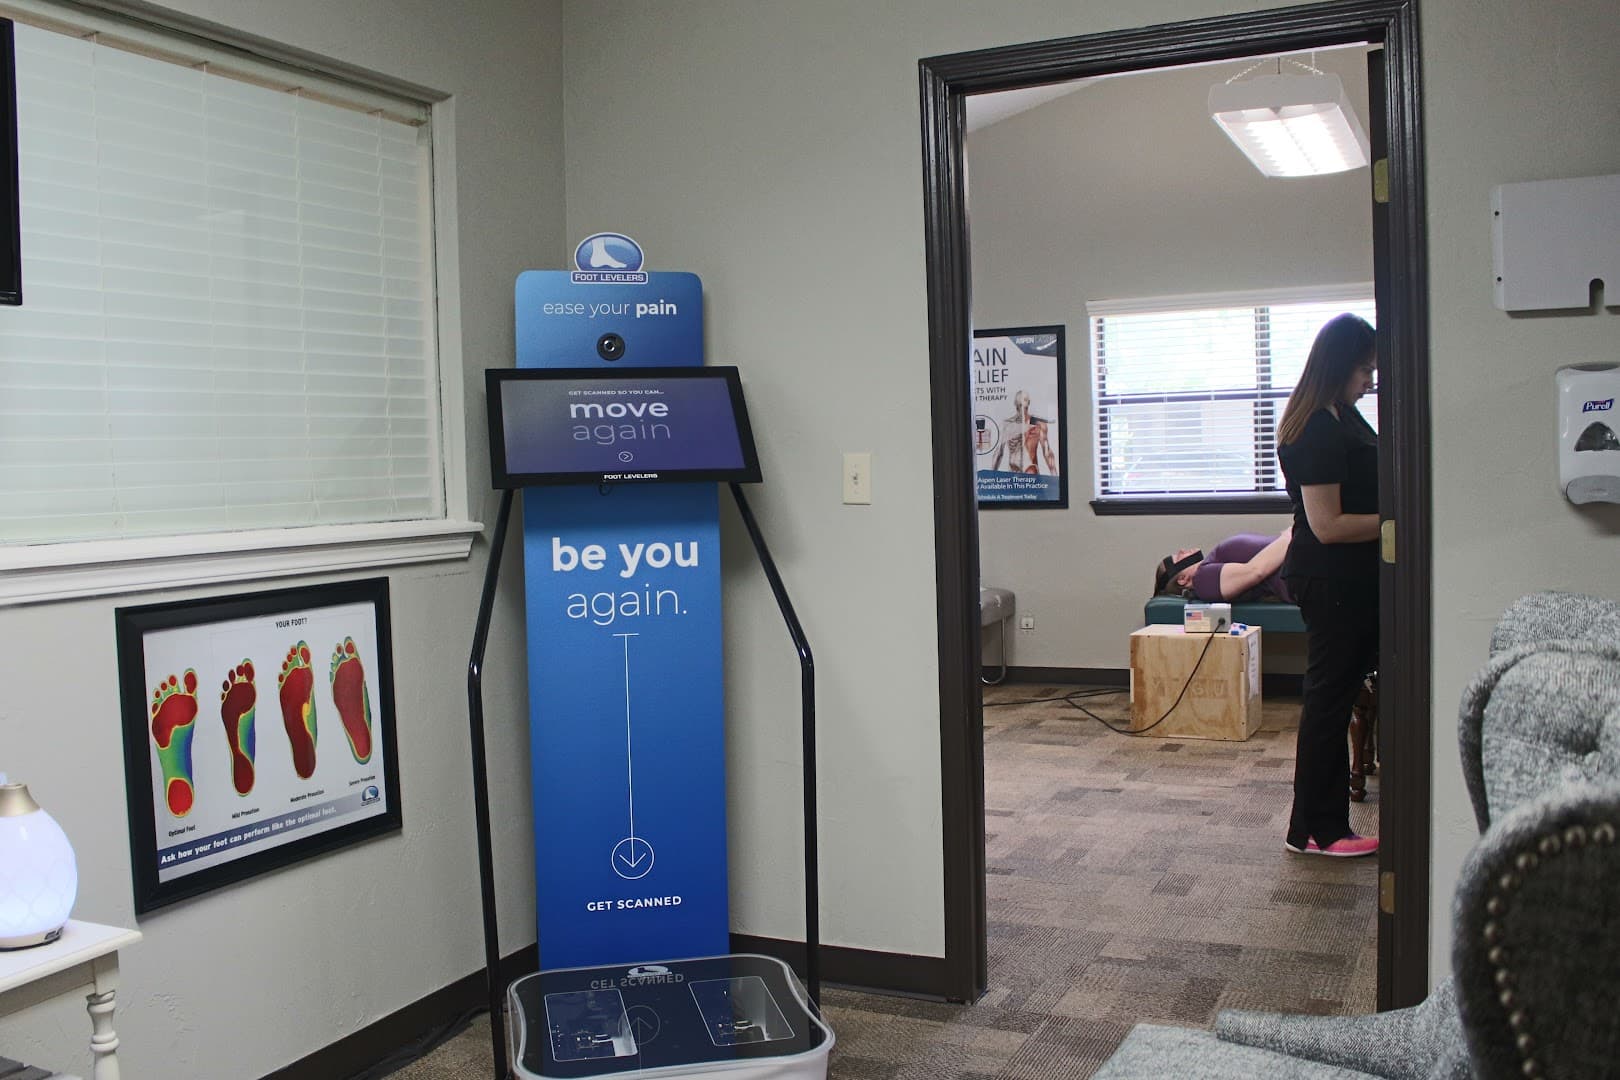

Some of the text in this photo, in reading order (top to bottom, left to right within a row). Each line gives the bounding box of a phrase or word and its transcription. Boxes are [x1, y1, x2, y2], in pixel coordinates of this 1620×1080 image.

[575, 273, 644, 282] FOOT LEVELERS
[543, 299, 677, 319] ease your pain
[975, 369, 1008, 384] LIEF
[987, 386, 1006, 394] WITH
[569, 402, 669, 418] move
[572, 419, 671, 445] again
[1012, 476, 1036, 484] Therapy
[552, 537, 698, 578] be you
[566, 583, 687, 626] again.
[275, 620, 290, 629] YOUR
[161, 855, 176, 864] Ask
[178, 848, 192, 859] how
[194, 843, 211, 855] your
[213, 837, 228, 849] foot
[230, 834, 242, 843] can
[243, 826, 270, 841] perform
[272, 821, 283, 831] like
[285, 817, 296, 826] the
[297, 811, 321, 825] optimal
[587, 896, 682, 911] GET SCANNED
